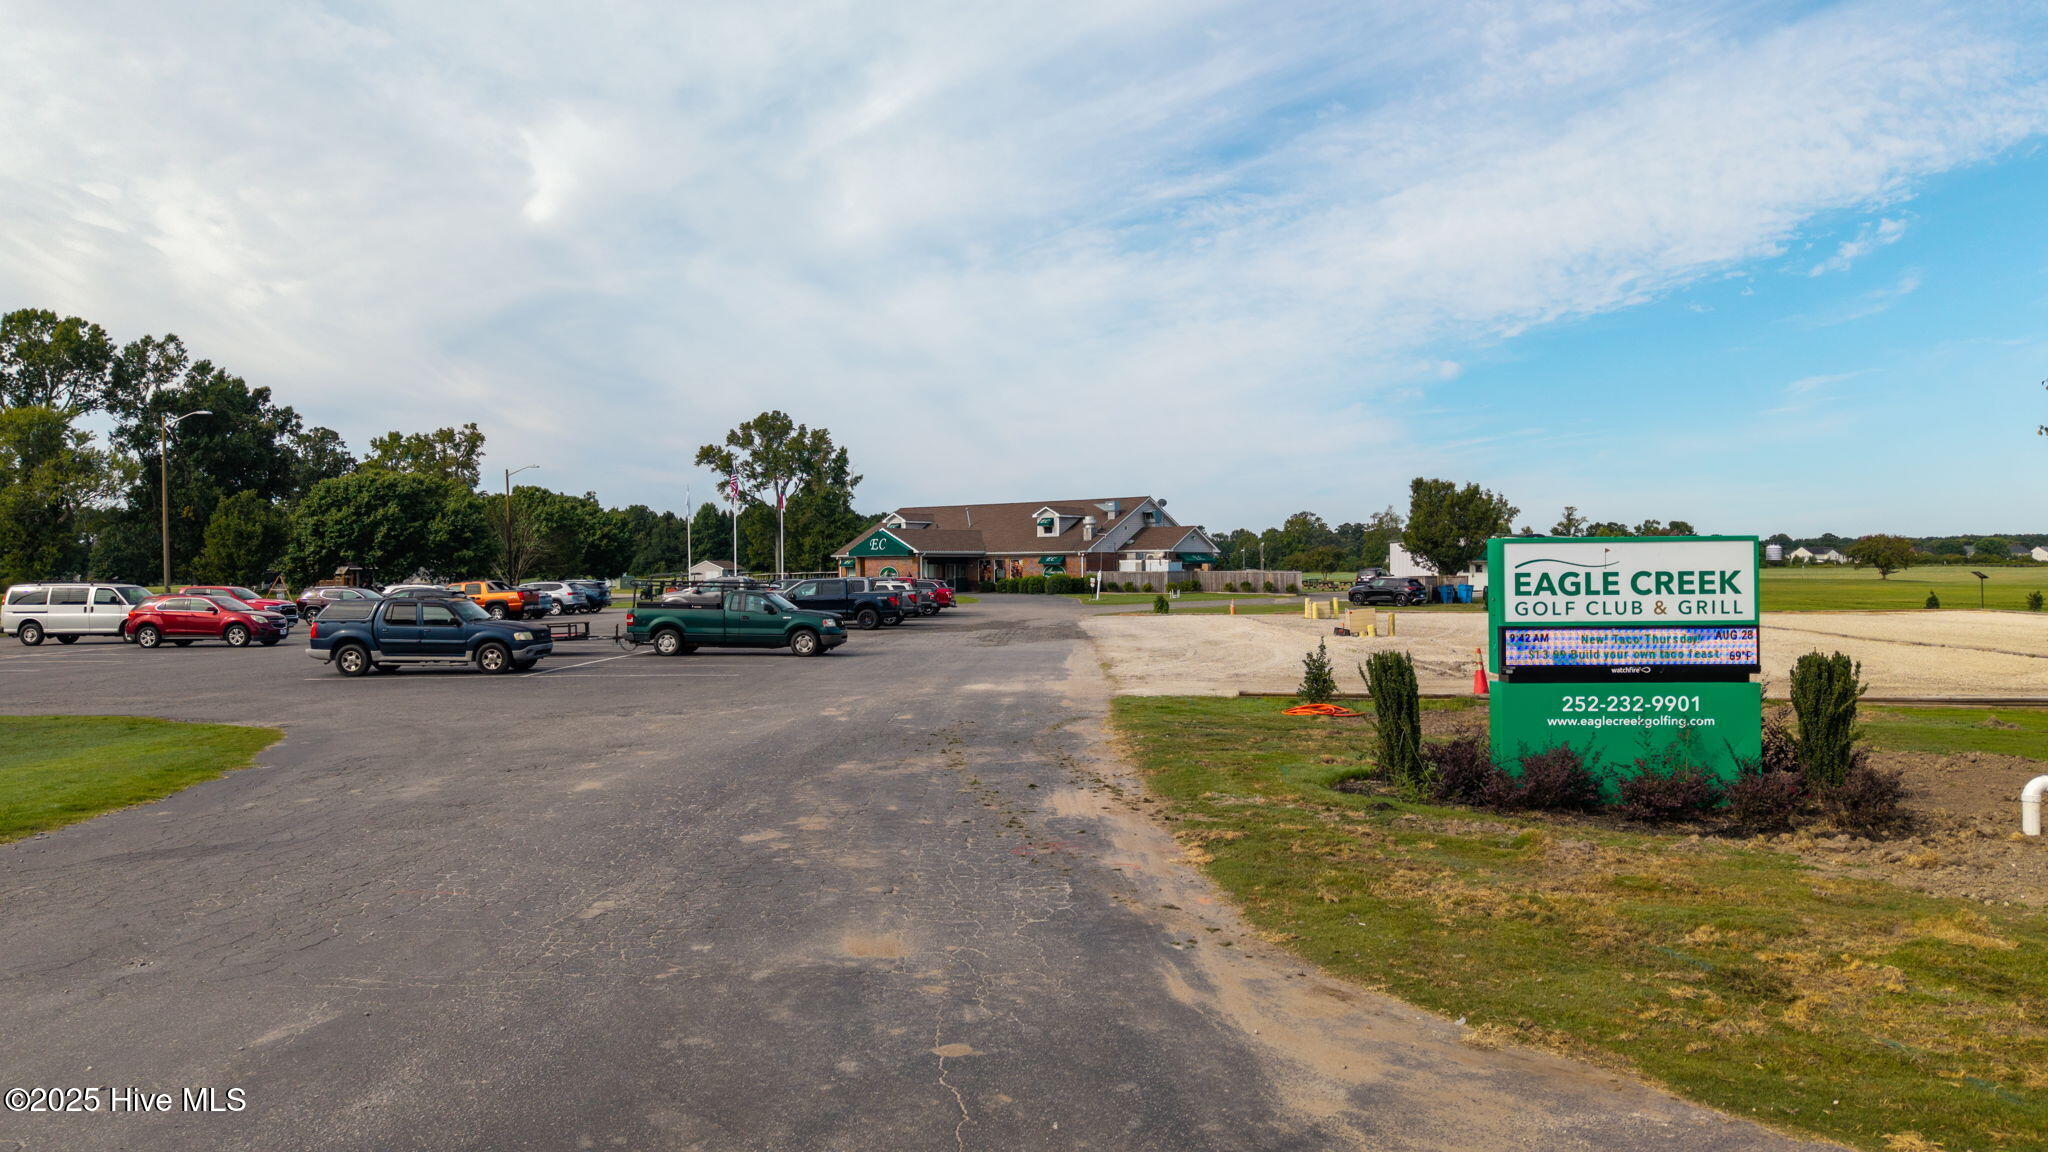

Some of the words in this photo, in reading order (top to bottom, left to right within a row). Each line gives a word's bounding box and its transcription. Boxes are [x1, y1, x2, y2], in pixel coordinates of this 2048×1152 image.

[869, 538, 887, 551] EC
[1514, 571, 1621, 596] EAGLE
[1630, 570, 1742, 595] CREEK
[1514, 601, 1576, 616] GOLF
[1586, 600, 1643, 616] CLUB
[1653, 600, 1668, 615] &
[1678, 599, 1743, 615] GRILL
[1533, 633, 1549, 643] AM
[1611, 634, 1640, 645] Taco
[1741, 630, 1754, 640] 28
[1570, 649, 1600, 660] Build
[1603, 651, 1629, 662] your
[1633, 651, 1656, 660] own
[1659, 650, 1684, 660] taco
[1688, 649, 1721, 659] feast
[1611, 665, 1641, 674] watchfire
[1561, 695, 1701, 712] 252-232-9901
[1546, 715, 1716, 729] www.eaglecreekgolfing.com
